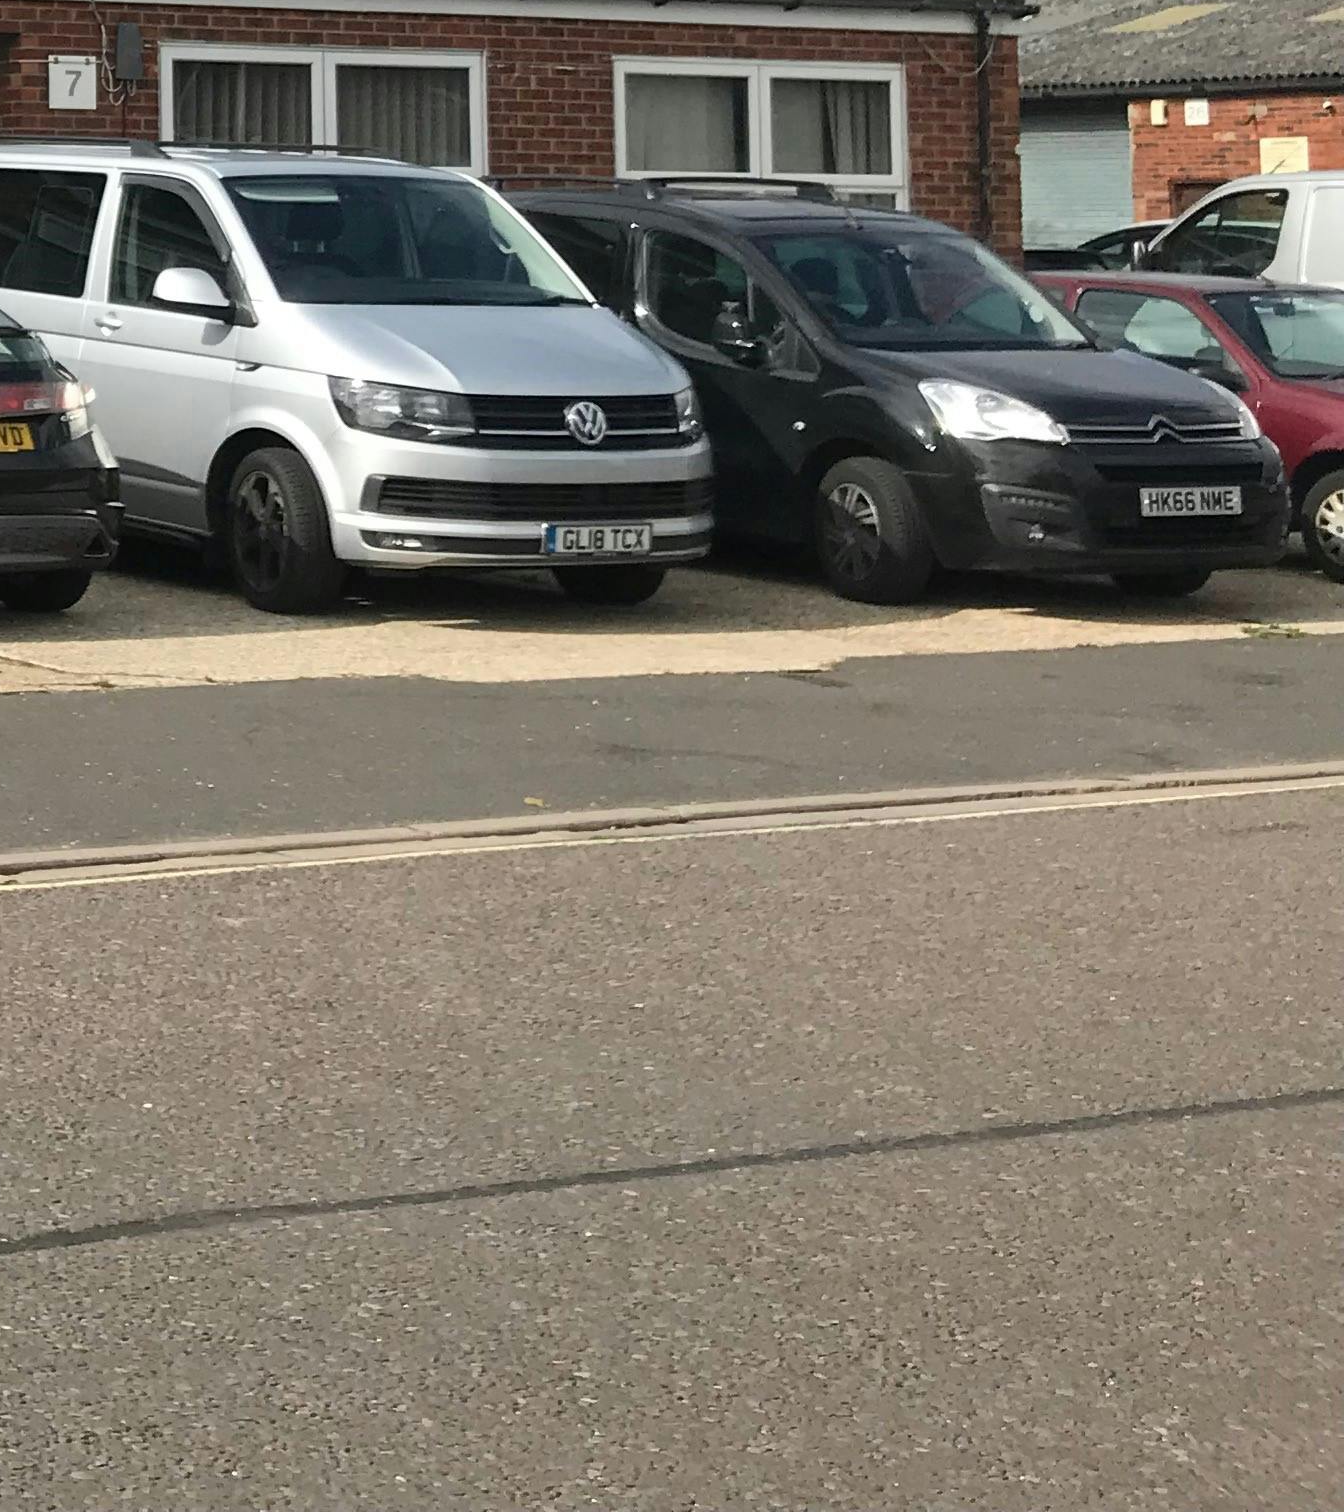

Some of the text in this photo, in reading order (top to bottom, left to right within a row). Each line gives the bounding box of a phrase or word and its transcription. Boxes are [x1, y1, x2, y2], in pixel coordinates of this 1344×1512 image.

[64, 70, 82, 97] 7
[1148, 490, 1234, 513] HK66 NME
[562, 528, 645, 551] GL18 TCX
